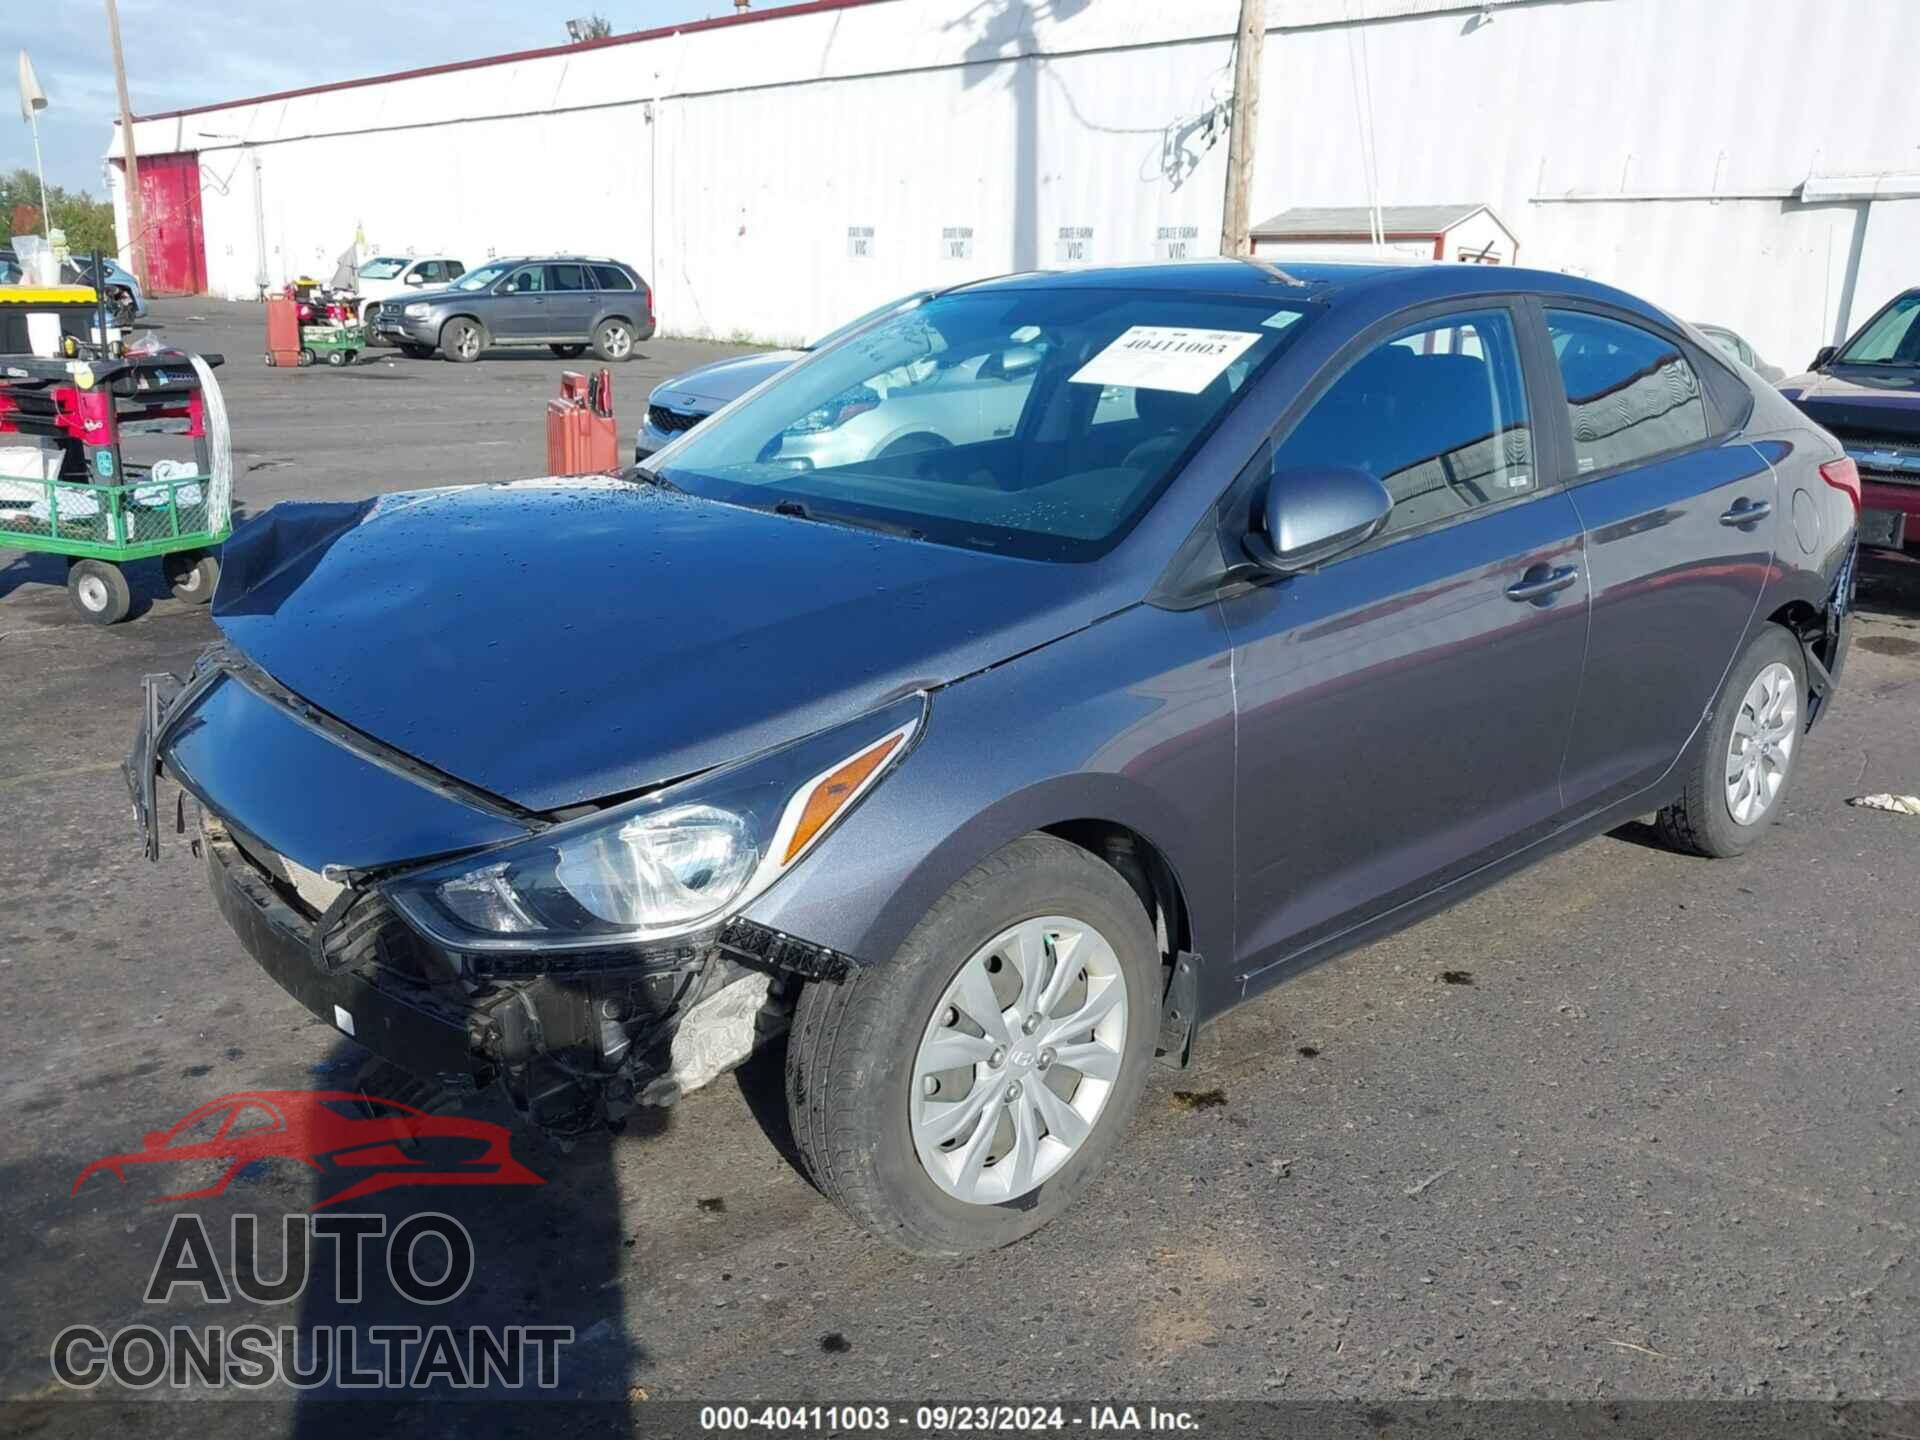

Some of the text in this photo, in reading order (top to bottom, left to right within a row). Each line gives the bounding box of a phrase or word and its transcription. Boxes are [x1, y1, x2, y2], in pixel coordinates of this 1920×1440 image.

[1058, 226, 1094, 239] STATE FARM
[1158, 226, 1198, 240] STATE FARM
[1067, 241, 1083, 260] VIC
[1168, 241, 1186, 260] VIC
[1124, 338, 1228, 356] 40411003
